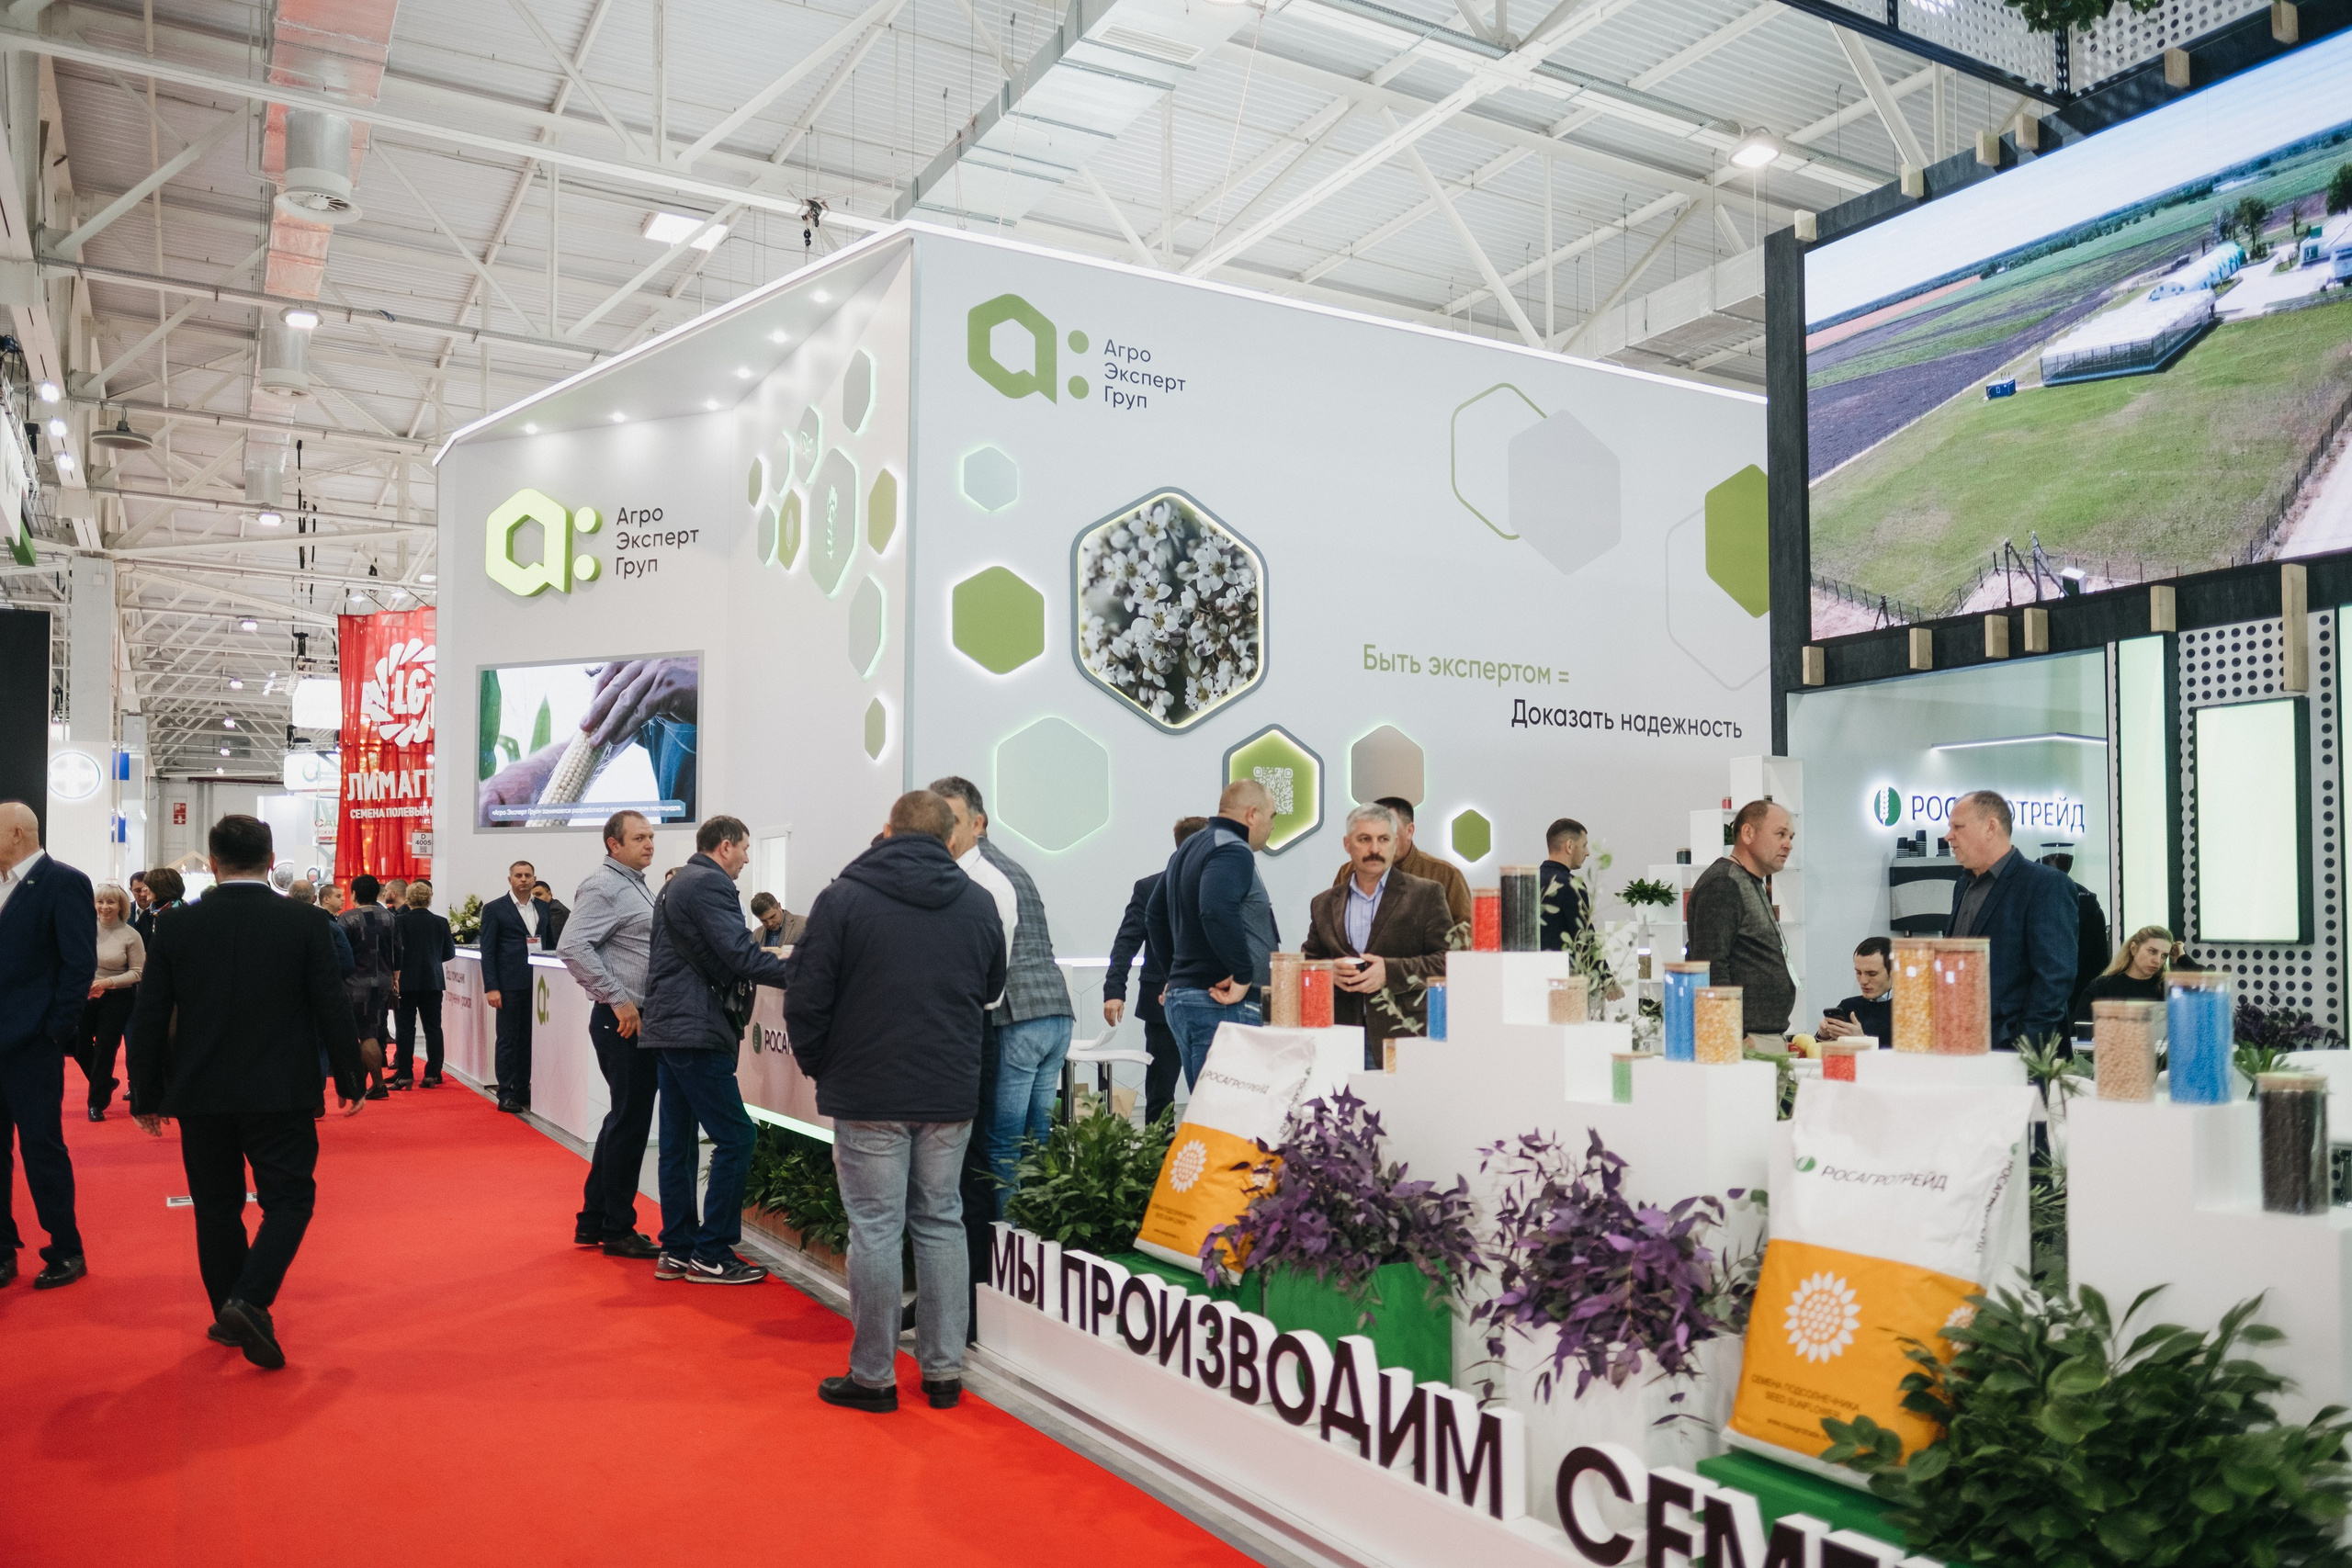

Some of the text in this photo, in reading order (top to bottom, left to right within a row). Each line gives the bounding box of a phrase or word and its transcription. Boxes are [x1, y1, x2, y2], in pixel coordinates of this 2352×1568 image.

[1104, 338, 1151, 364] Агро
[1104, 362, 1186, 393] Эксперт
[1105, 385, 1148, 410] Груп
[616, 507, 663, 528] Агро
[616, 529, 699, 550] Эксперт
[616, 557, 658, 580] Груп
[1363, 644, 1421, 675] Быть
[1428, 656, 1552, 687] экспертом
[1511, 698, 1743, 739] Доказать надежность
[350, 808, 385, 819] СЕМЕНА
[987, 1223, 1046, 1313] МЫ
[1060, 1250, 1504, 1521] ПРОИЗВОДИМ
